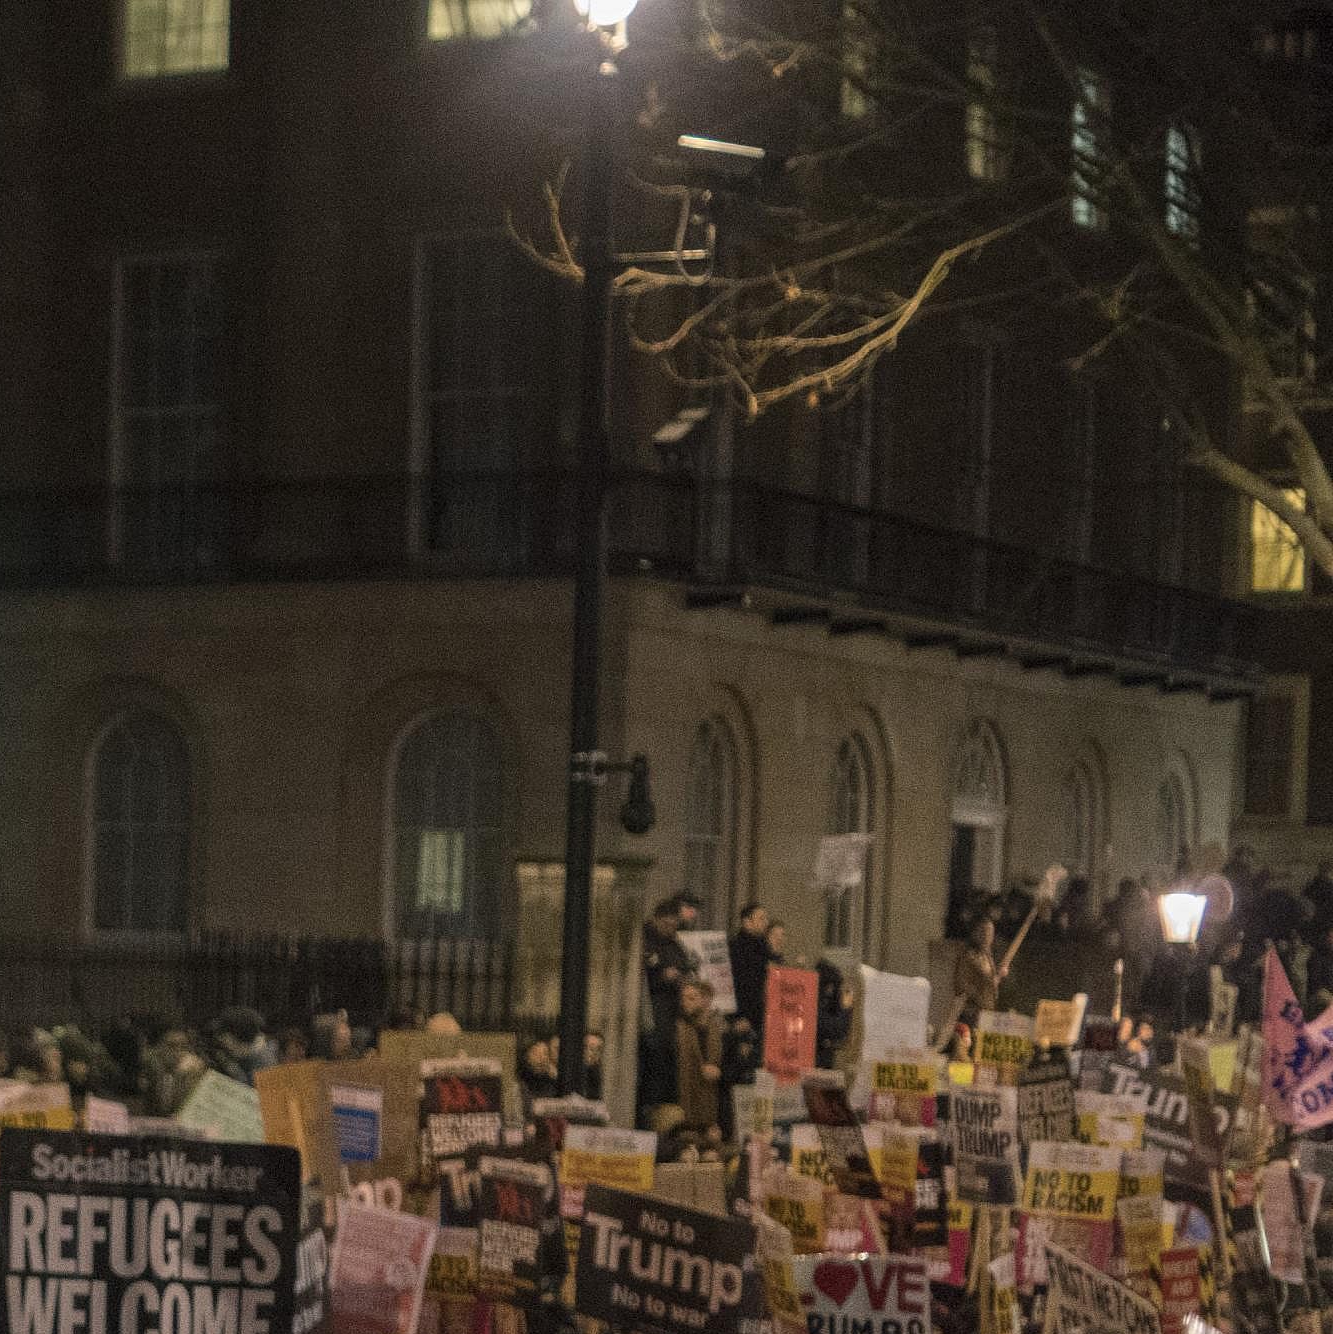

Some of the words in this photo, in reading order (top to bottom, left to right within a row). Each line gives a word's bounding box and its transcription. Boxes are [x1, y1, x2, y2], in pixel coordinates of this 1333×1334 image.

[31, 1143, 264, 1191] SocialistWorker
[1066, 1173, 1092, 1193] TO
[9, 1191, 283, 1286] REFUGEES
[639, 1211, 670, 1237] No
[673, 1219, 696, 1243] to
[586, 1212, 743, 1313] Trump
[611, 1284, 640, 1310] No
[645, 1295, 667, 1316] to
[670, 1305, 709, 1329] war
